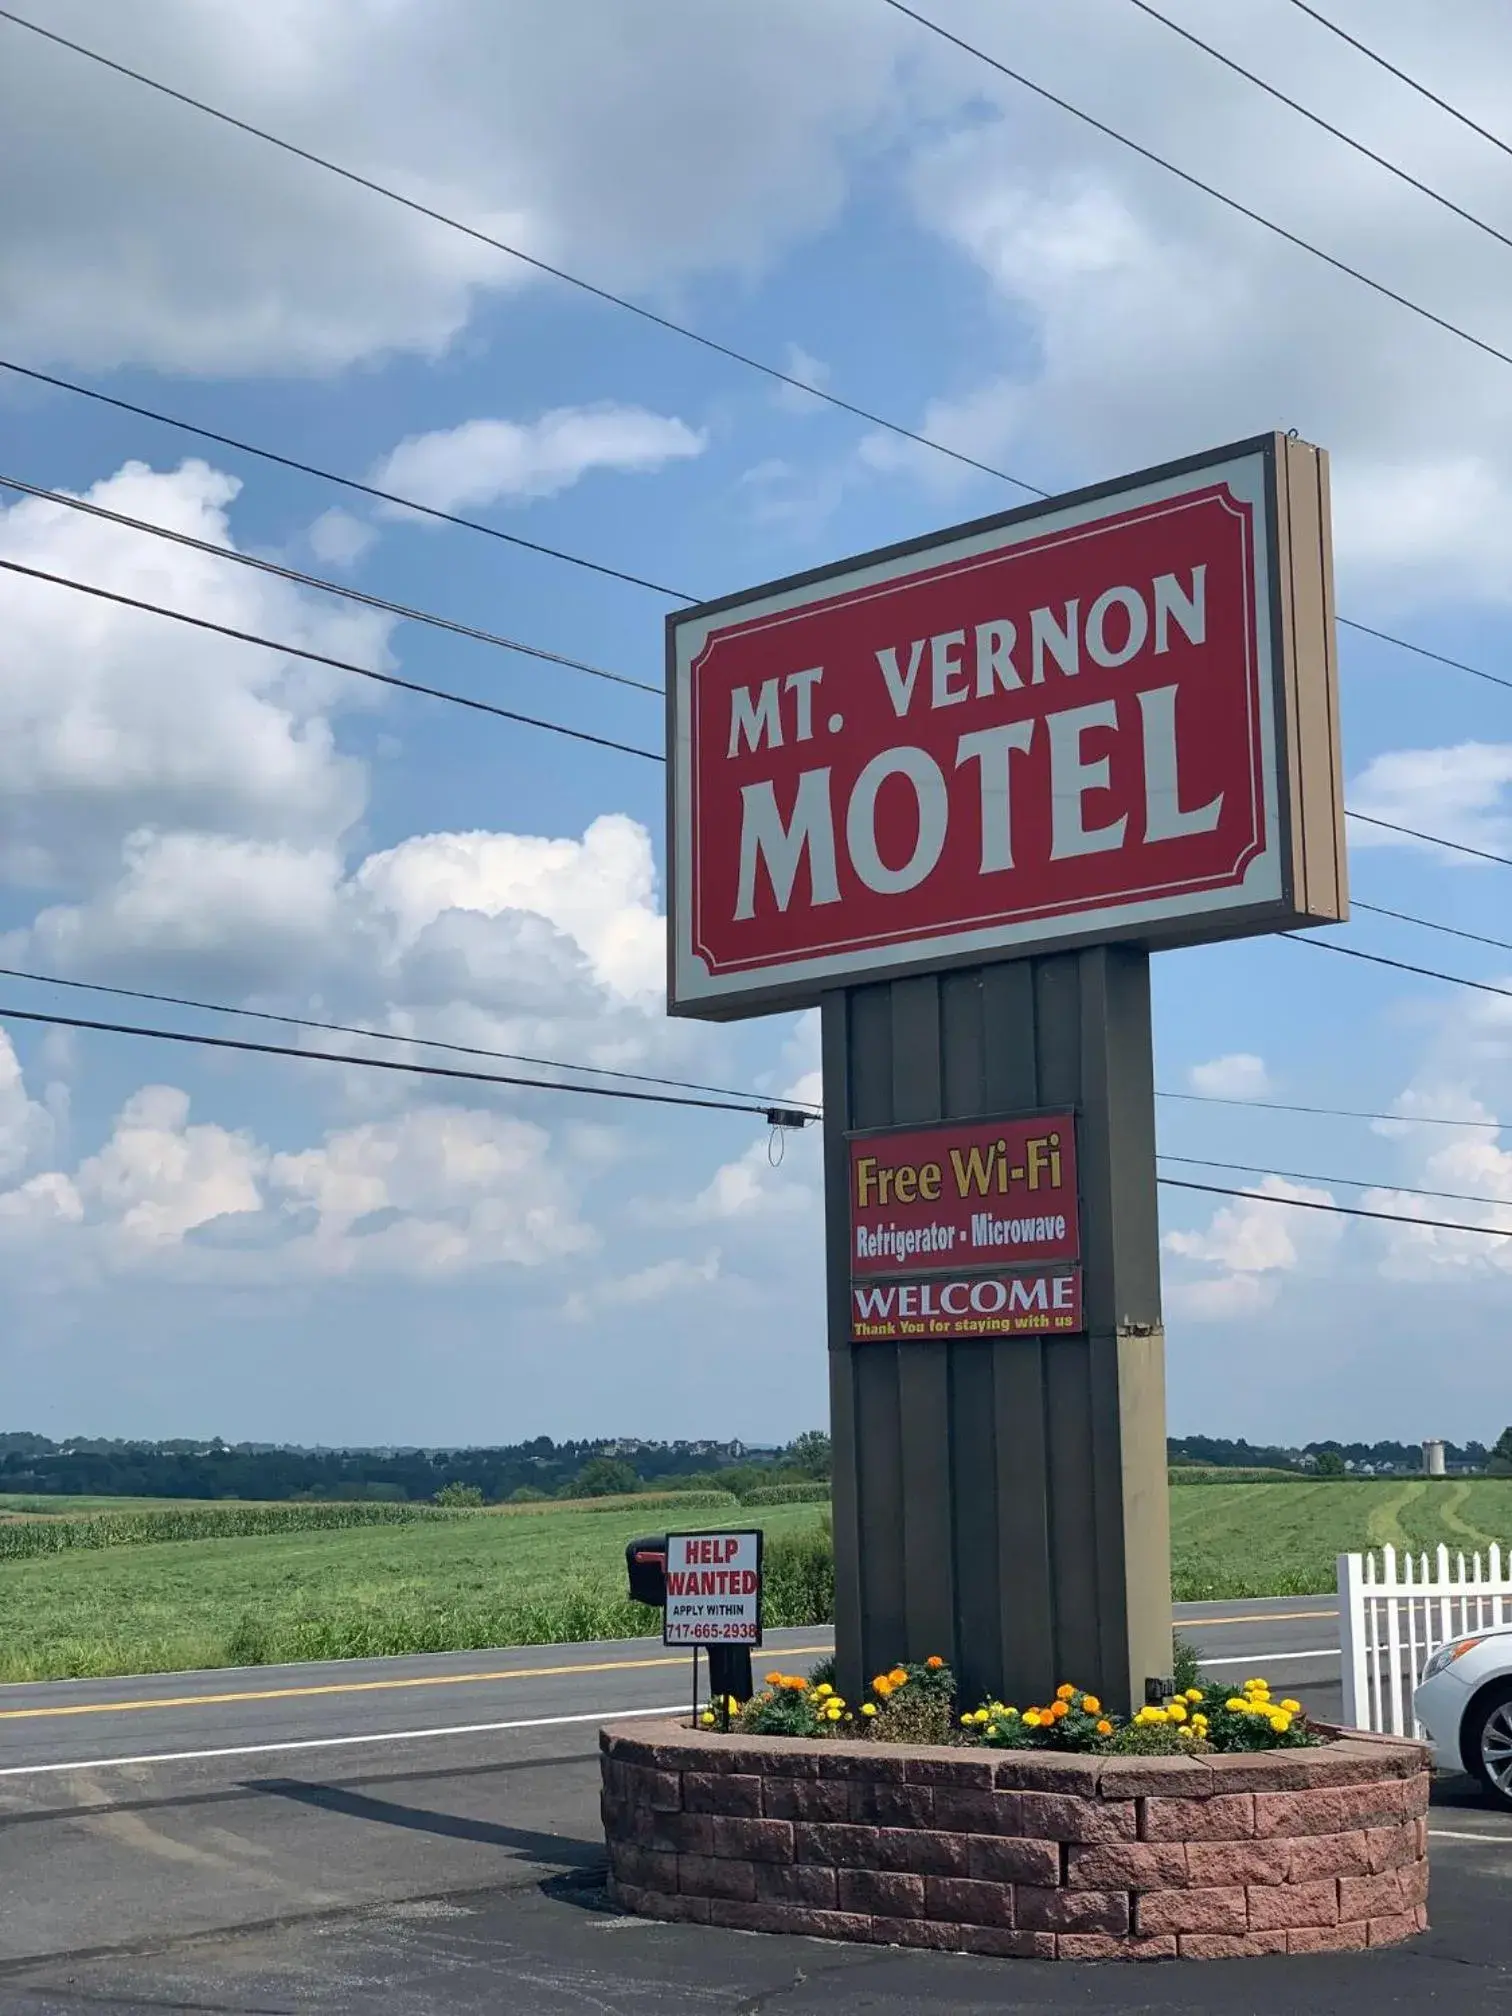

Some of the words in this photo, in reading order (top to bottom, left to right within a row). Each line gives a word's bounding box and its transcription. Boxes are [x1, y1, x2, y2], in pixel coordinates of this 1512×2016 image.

[726, 667, 843, 759] MT.
[874, 563, 1207, 717] VERNON
[733, 683, 1225, 921] MOTEL
[857, 1157, 942, 1208] Free
[950, 1133, 1062, 1198] Wi-Fi
[857, 1221, 955, 1262] Refrigerator
[971, 1212, 1066, 1247] Microwave
[854, 1276, 1074, 1319] WELCOME
[854, 1322, 895, 1336] Thank
[900, 1319, 925, 1334] You
[930, 1318, 950, 1333] for
[954, 1316, 1011, 1334] staying
[1015, 1315, 1050, 1328] with
[1055, 1315, 1073, 1327] us
[685, 1539, 738, 1564] HELP
[667, 1571, 759, 1596] WANTED
[673, 1605, 703, 1616] APPLY
[707, 1604, 744, 1616] WITHIN
